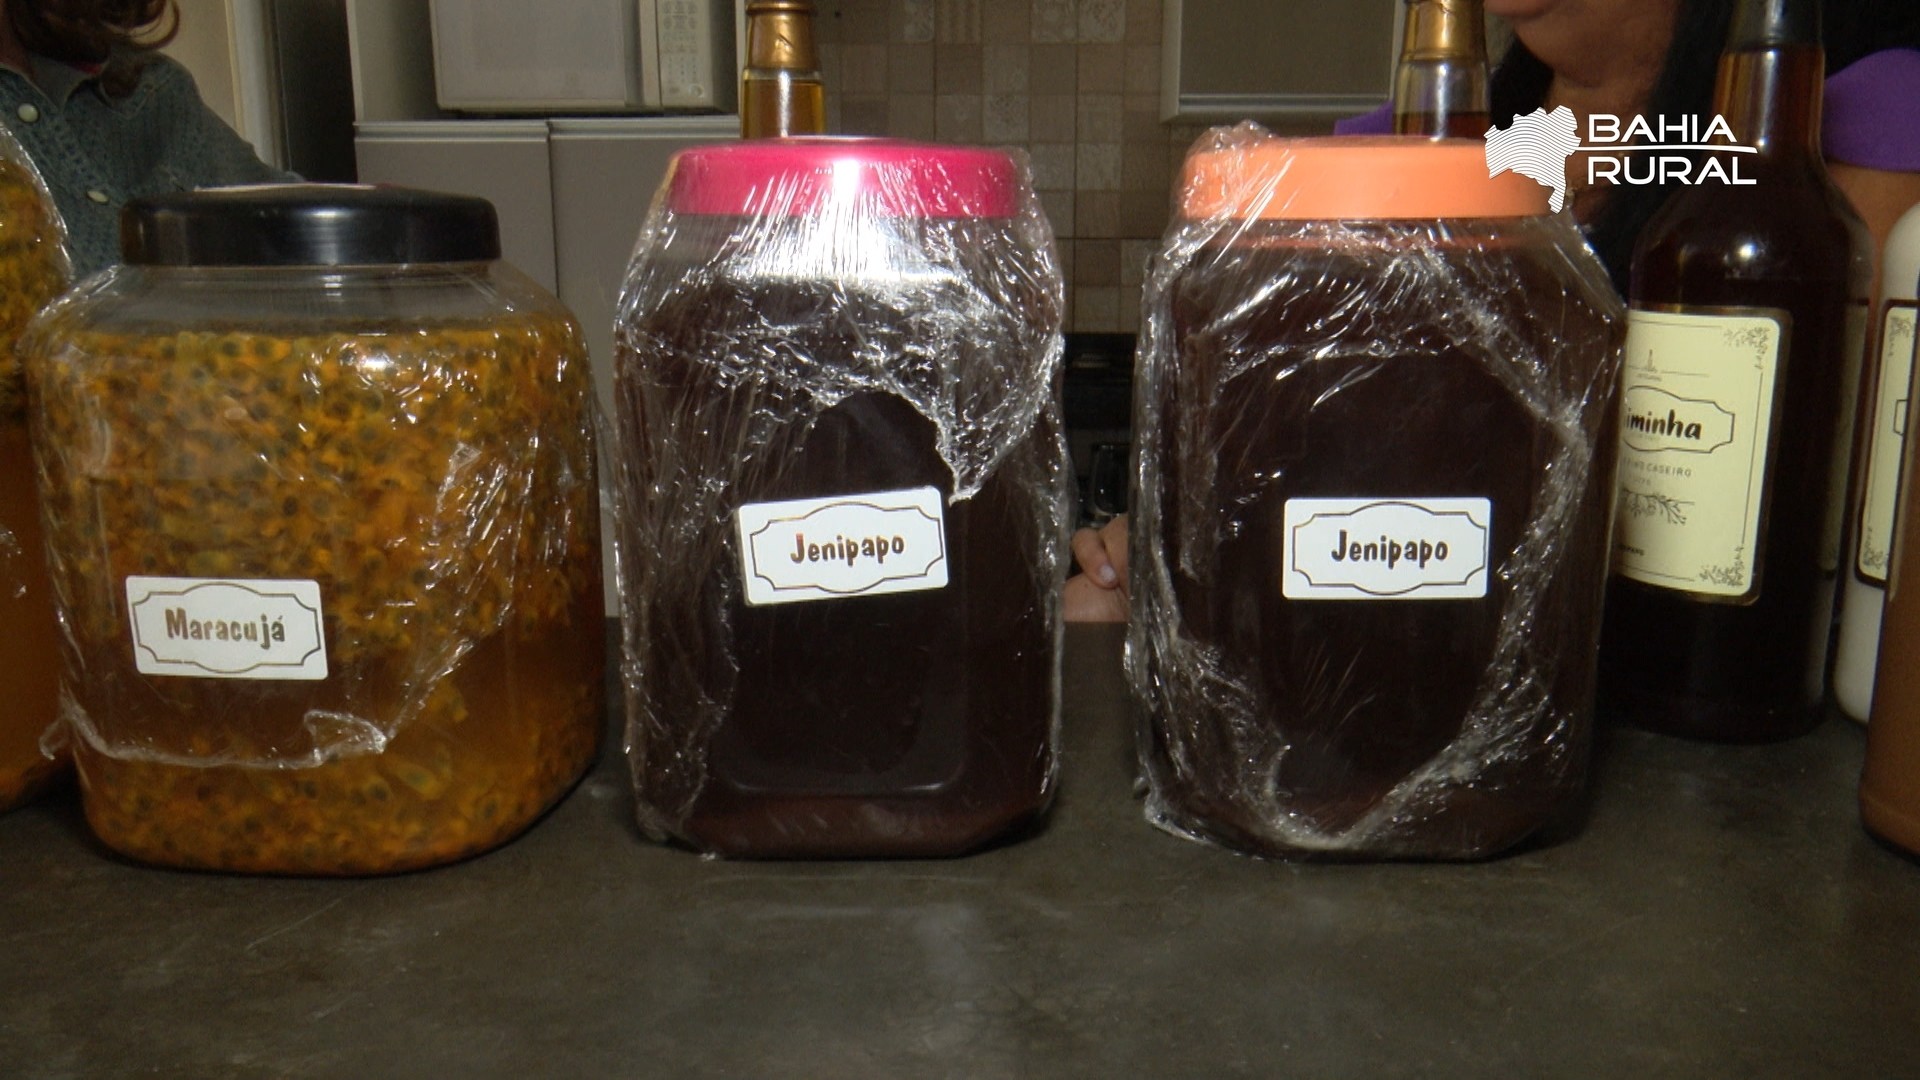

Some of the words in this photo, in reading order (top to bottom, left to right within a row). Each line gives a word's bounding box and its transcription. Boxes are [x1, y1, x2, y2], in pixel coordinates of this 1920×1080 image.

[1625, 406, 1702, 440] iminha
[1646, 463, 1692, 479] CASEIRO
[790, 533, 905, 567] Jenipapo
[1331, 529, 1448, 569] Jenipapo
[164, 607, 285, 650] Maracujá
